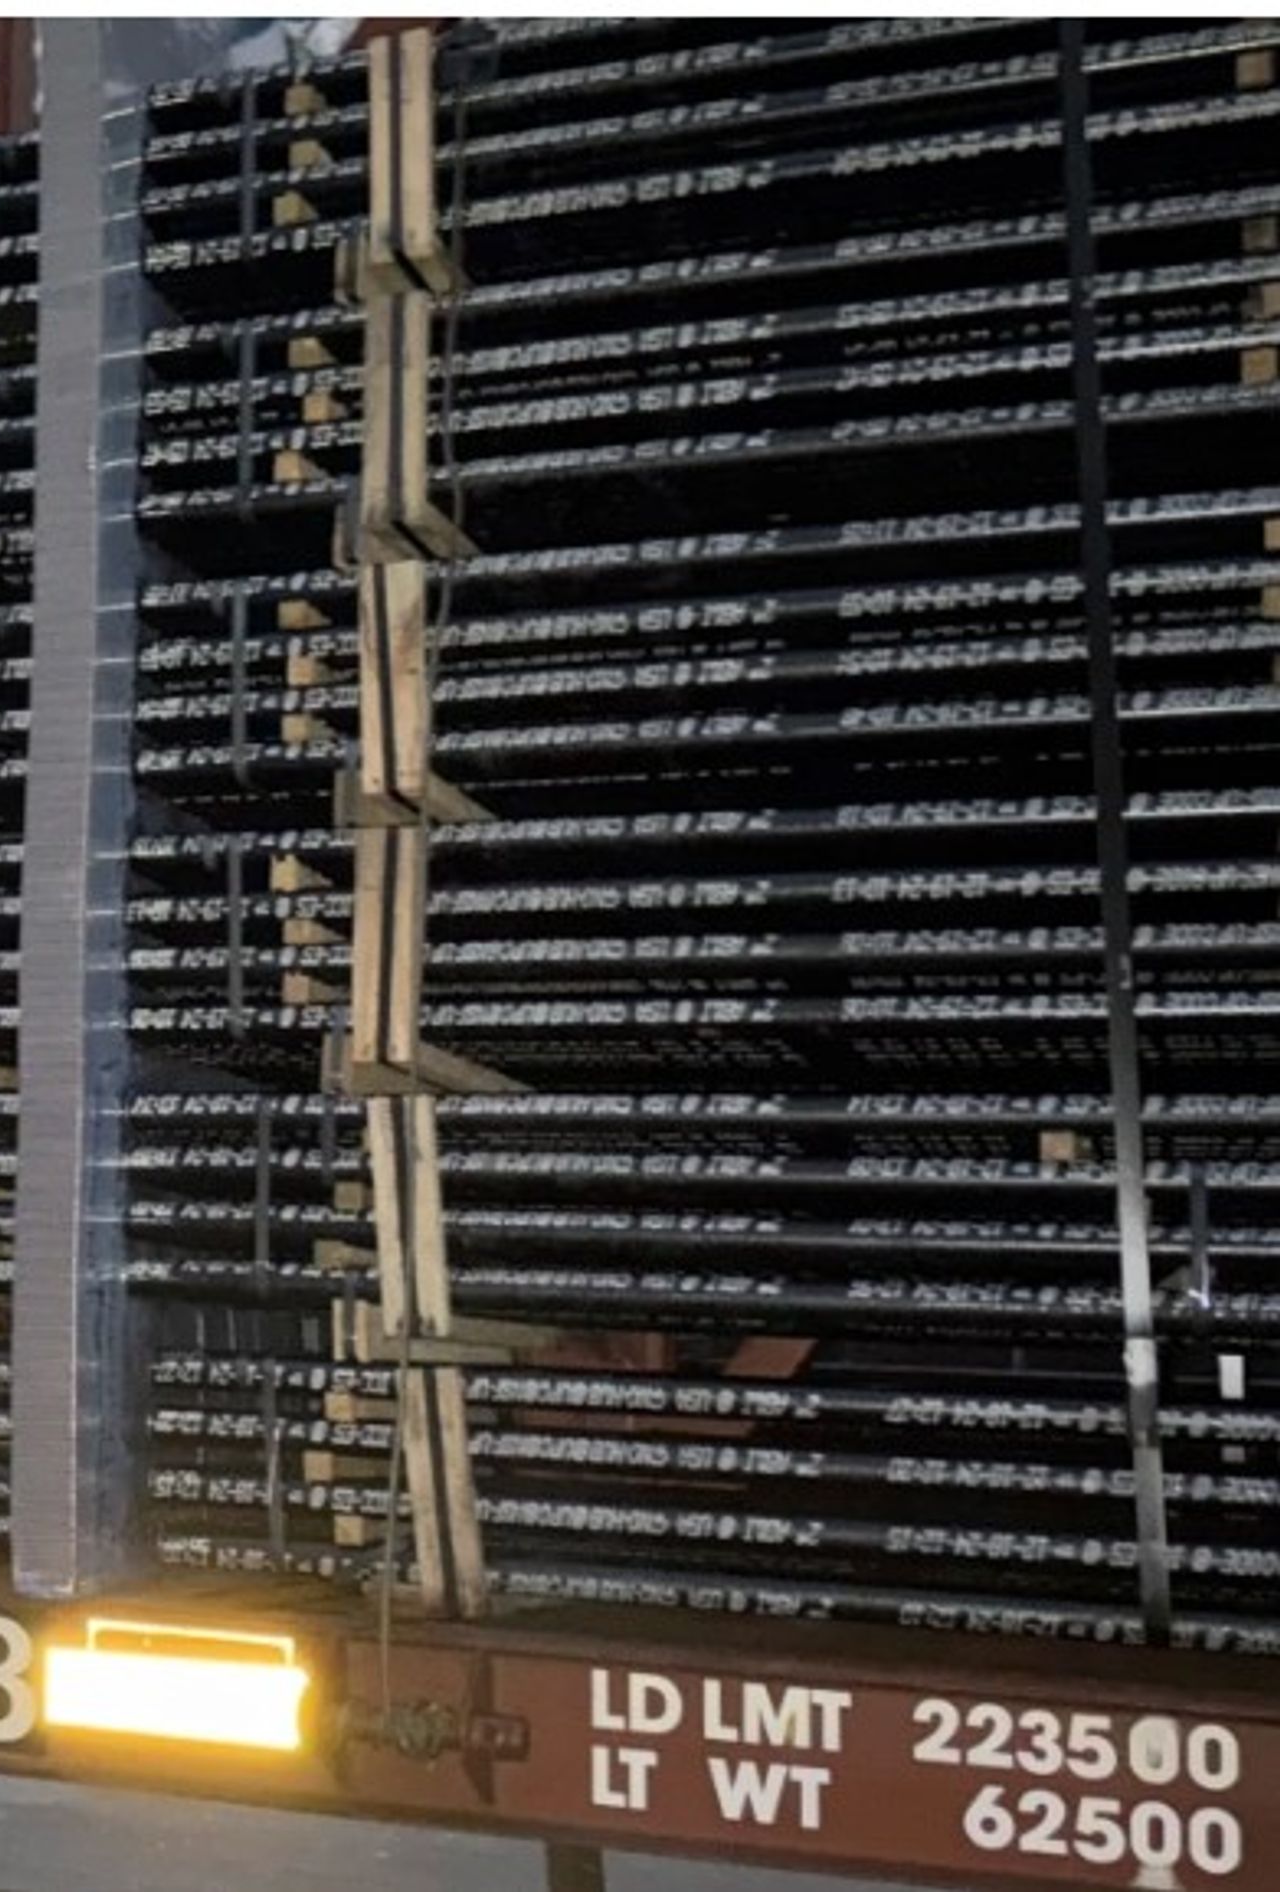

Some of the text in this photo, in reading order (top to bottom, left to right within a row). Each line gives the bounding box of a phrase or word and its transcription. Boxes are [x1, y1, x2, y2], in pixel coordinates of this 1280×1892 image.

[590, 1668, 1240, 1791] LD LMT 223500
[591, 1746, 1241, 1875] LT WT 62500
